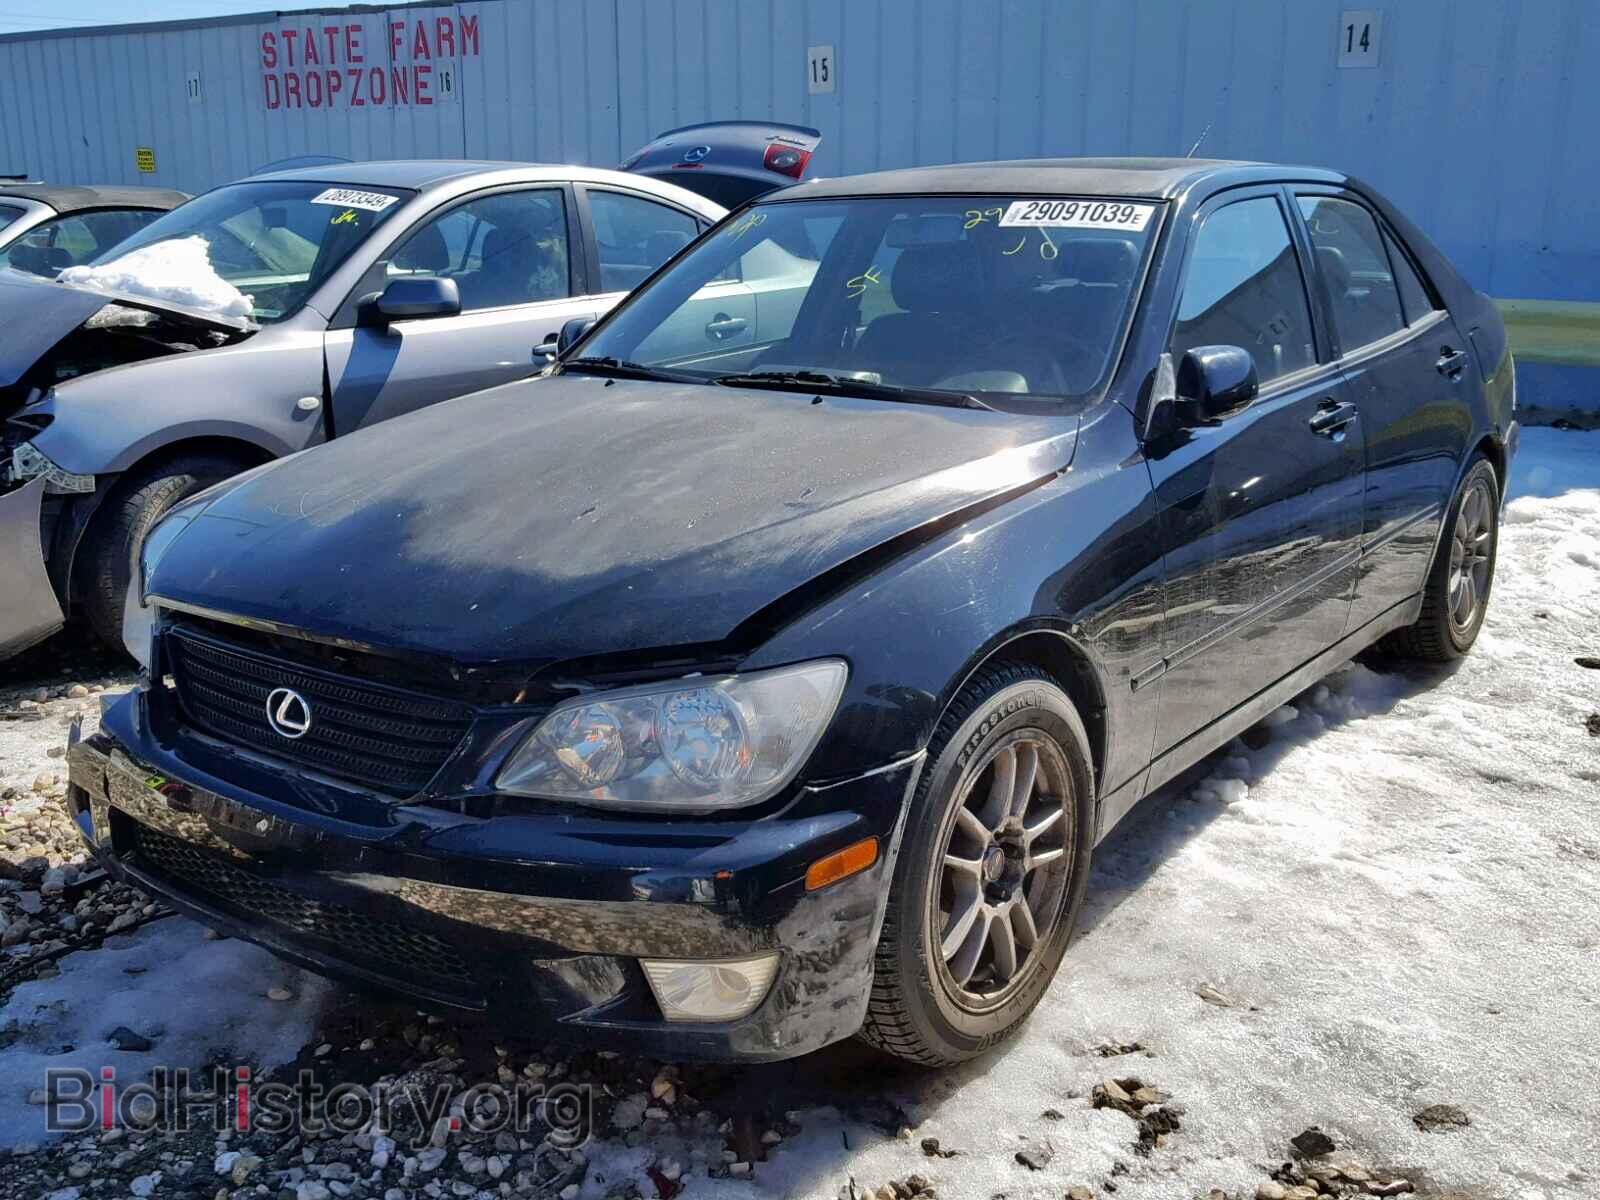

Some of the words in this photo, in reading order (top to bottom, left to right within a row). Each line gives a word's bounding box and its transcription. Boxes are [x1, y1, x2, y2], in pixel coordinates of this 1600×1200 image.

[261, 24, 363, 68] STATE
[390, 15, 480, 61] FARM
[1346, 23, 1370, 53] 14
[439, 71, 451, 93] 16
[811, 57, 829, 83] 15
[264, 65, 433, 110] DROPZONE
